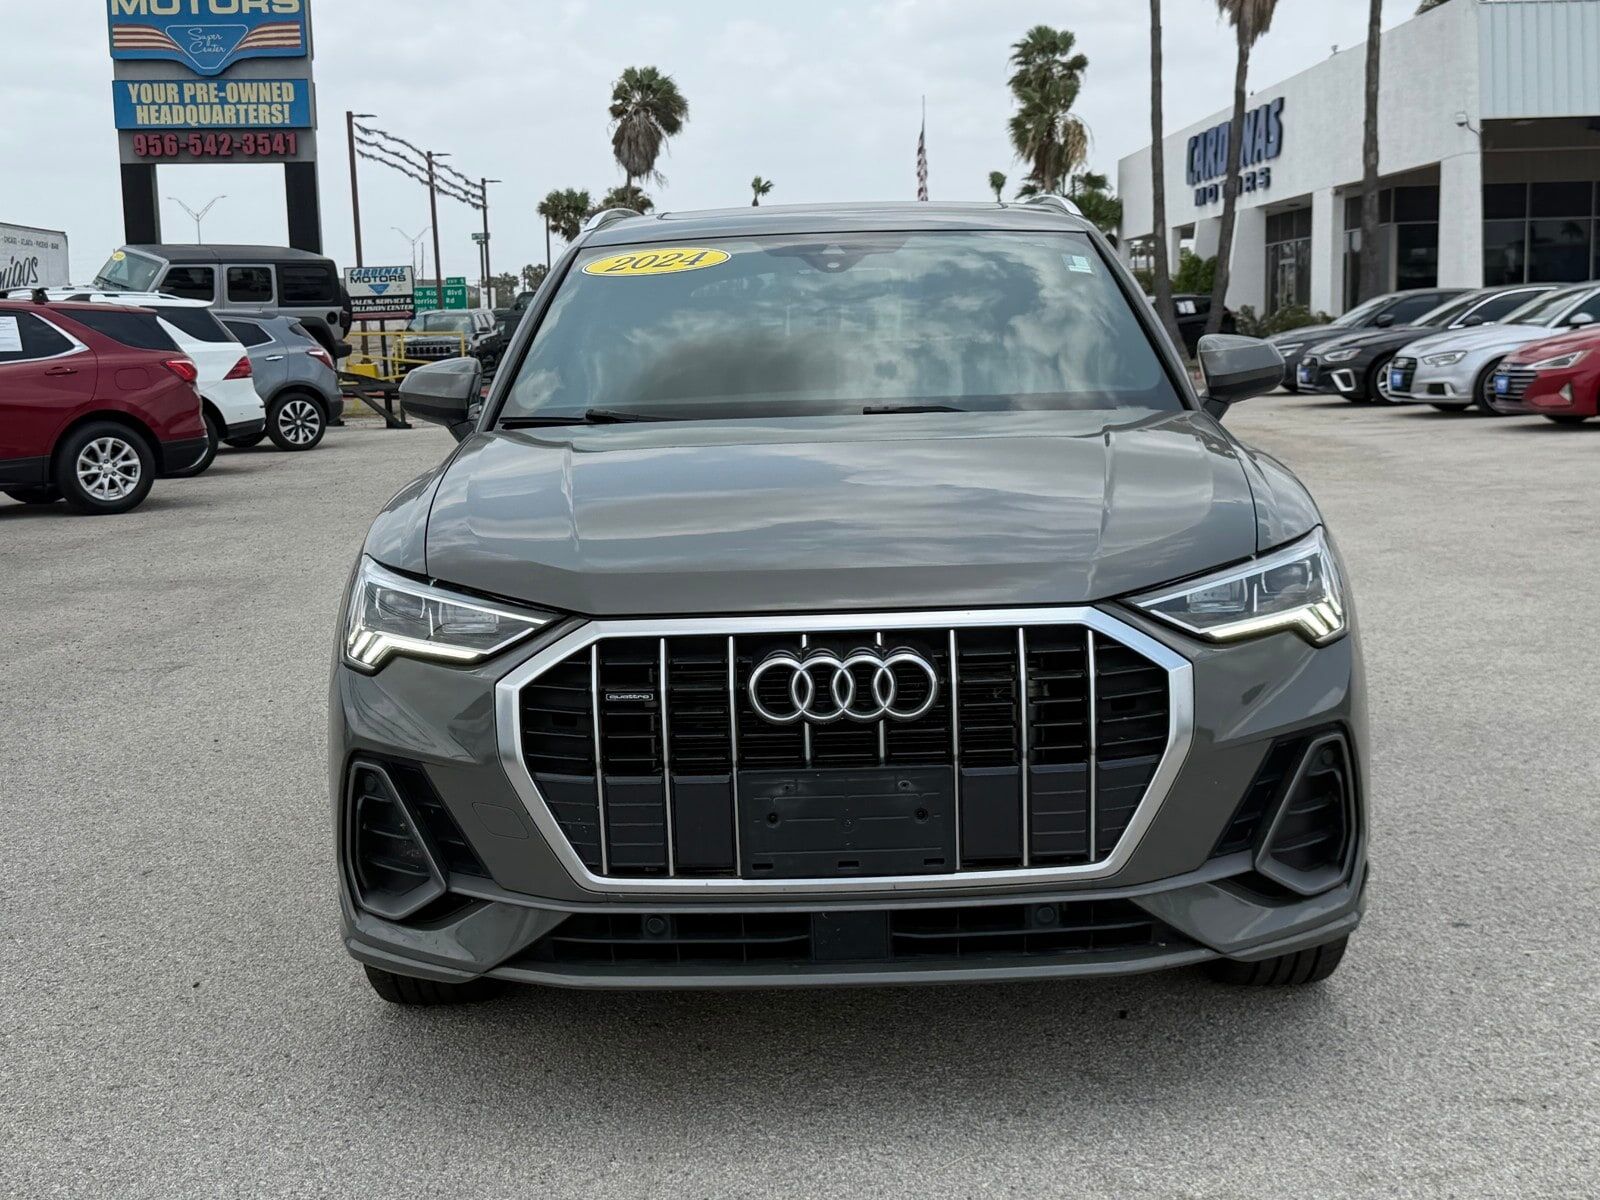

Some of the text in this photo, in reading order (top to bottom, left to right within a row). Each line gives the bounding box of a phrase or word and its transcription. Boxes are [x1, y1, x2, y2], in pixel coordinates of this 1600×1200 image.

[111, 0, 300, 15] MOTORS
[188, 28, 223, 47] Super
[190, 41, 226, 54] Center
[128, 82, 295, 104] YOUR PRE-OWNED
[136, 104, 291, 127] HEADQUARTERS!
[133, 132, 298, 158] 956-542-3541
[1186, 97, 1285, 186] CARDNAS
[1195, 167, 1271, 206] MORS
[604, 251, 709, 273] 2024
[350, 268, 405, 277] CARDENAS
[350, 275, 407, 284] MOTORS
[447, 288, 462, 296] Blvd
[375, 297, 405, 305] SERVICE
[414, 297, 438, 305] orriso
